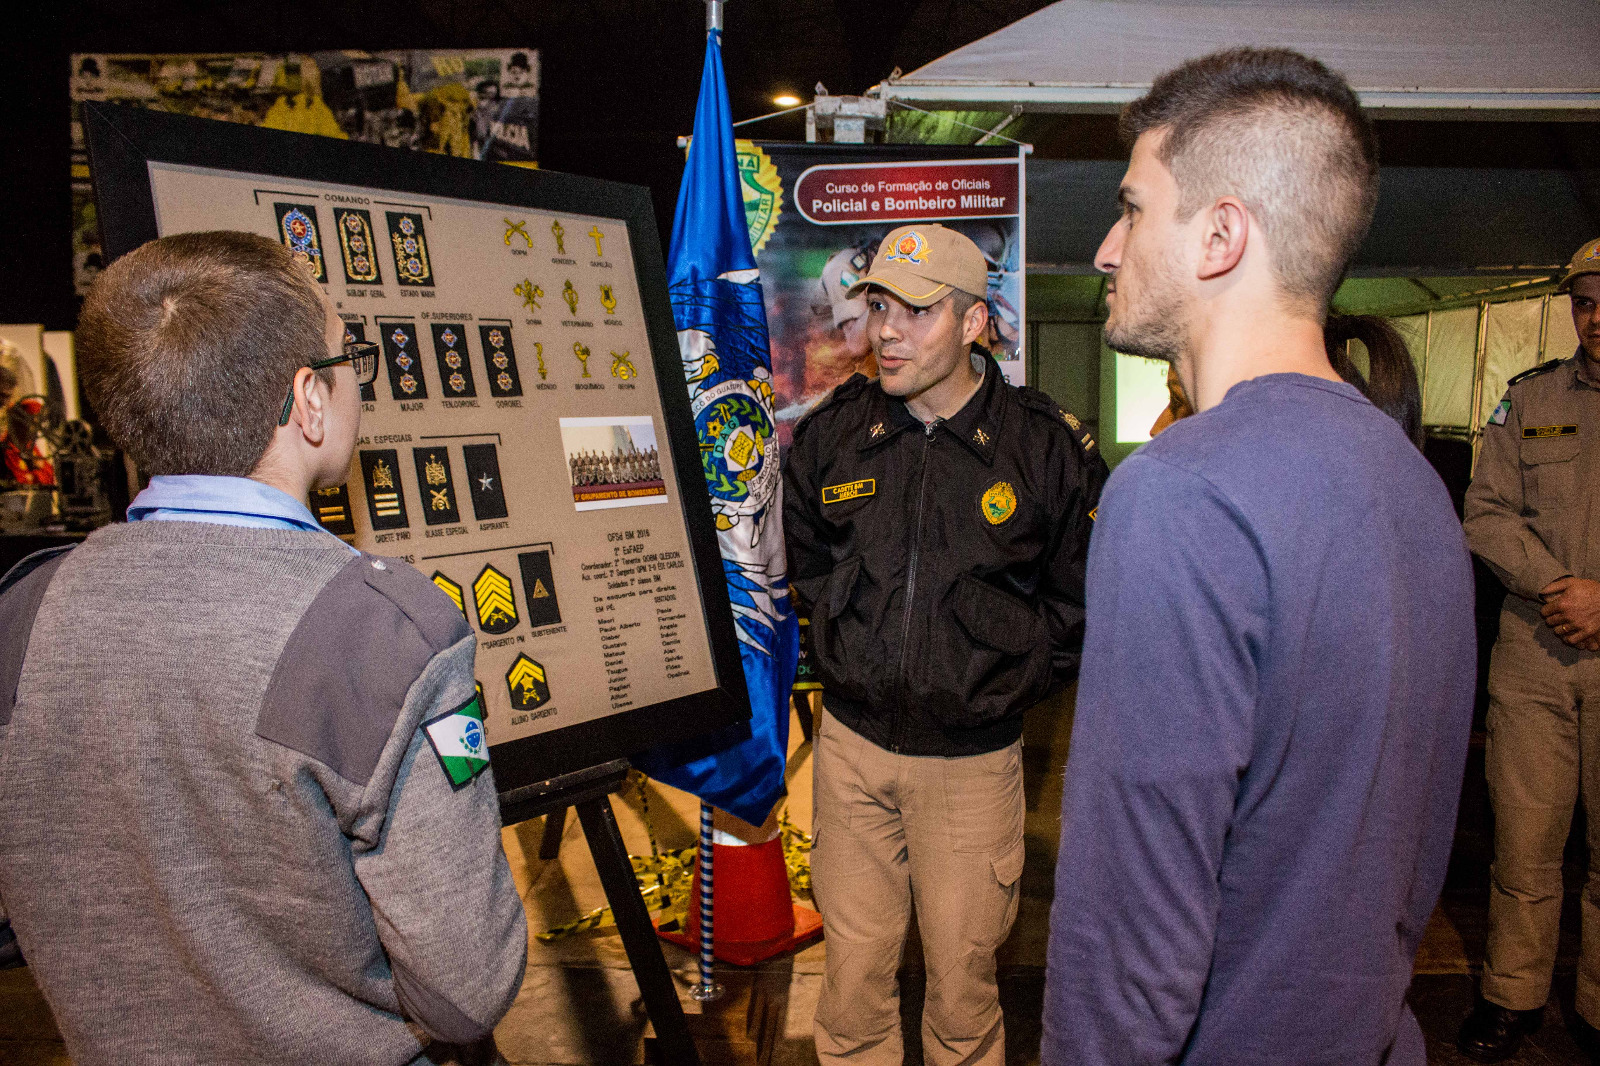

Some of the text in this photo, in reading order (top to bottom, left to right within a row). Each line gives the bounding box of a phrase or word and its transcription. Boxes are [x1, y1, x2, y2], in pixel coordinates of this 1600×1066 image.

[825, 178, 991, 194] Curso de Formação de Oficiais
[324, 193, 371, 205] COMANDO
[812, 194, 1006, 214] Policial e Bombeiro Militar
[400, 401, 425, 412] MAJOR
[495, 399, 524, 410] CORONEL
[373, 433, 413, 445] ESPECIAIS
[478, 521, 510, 533] ASPIRANTE
